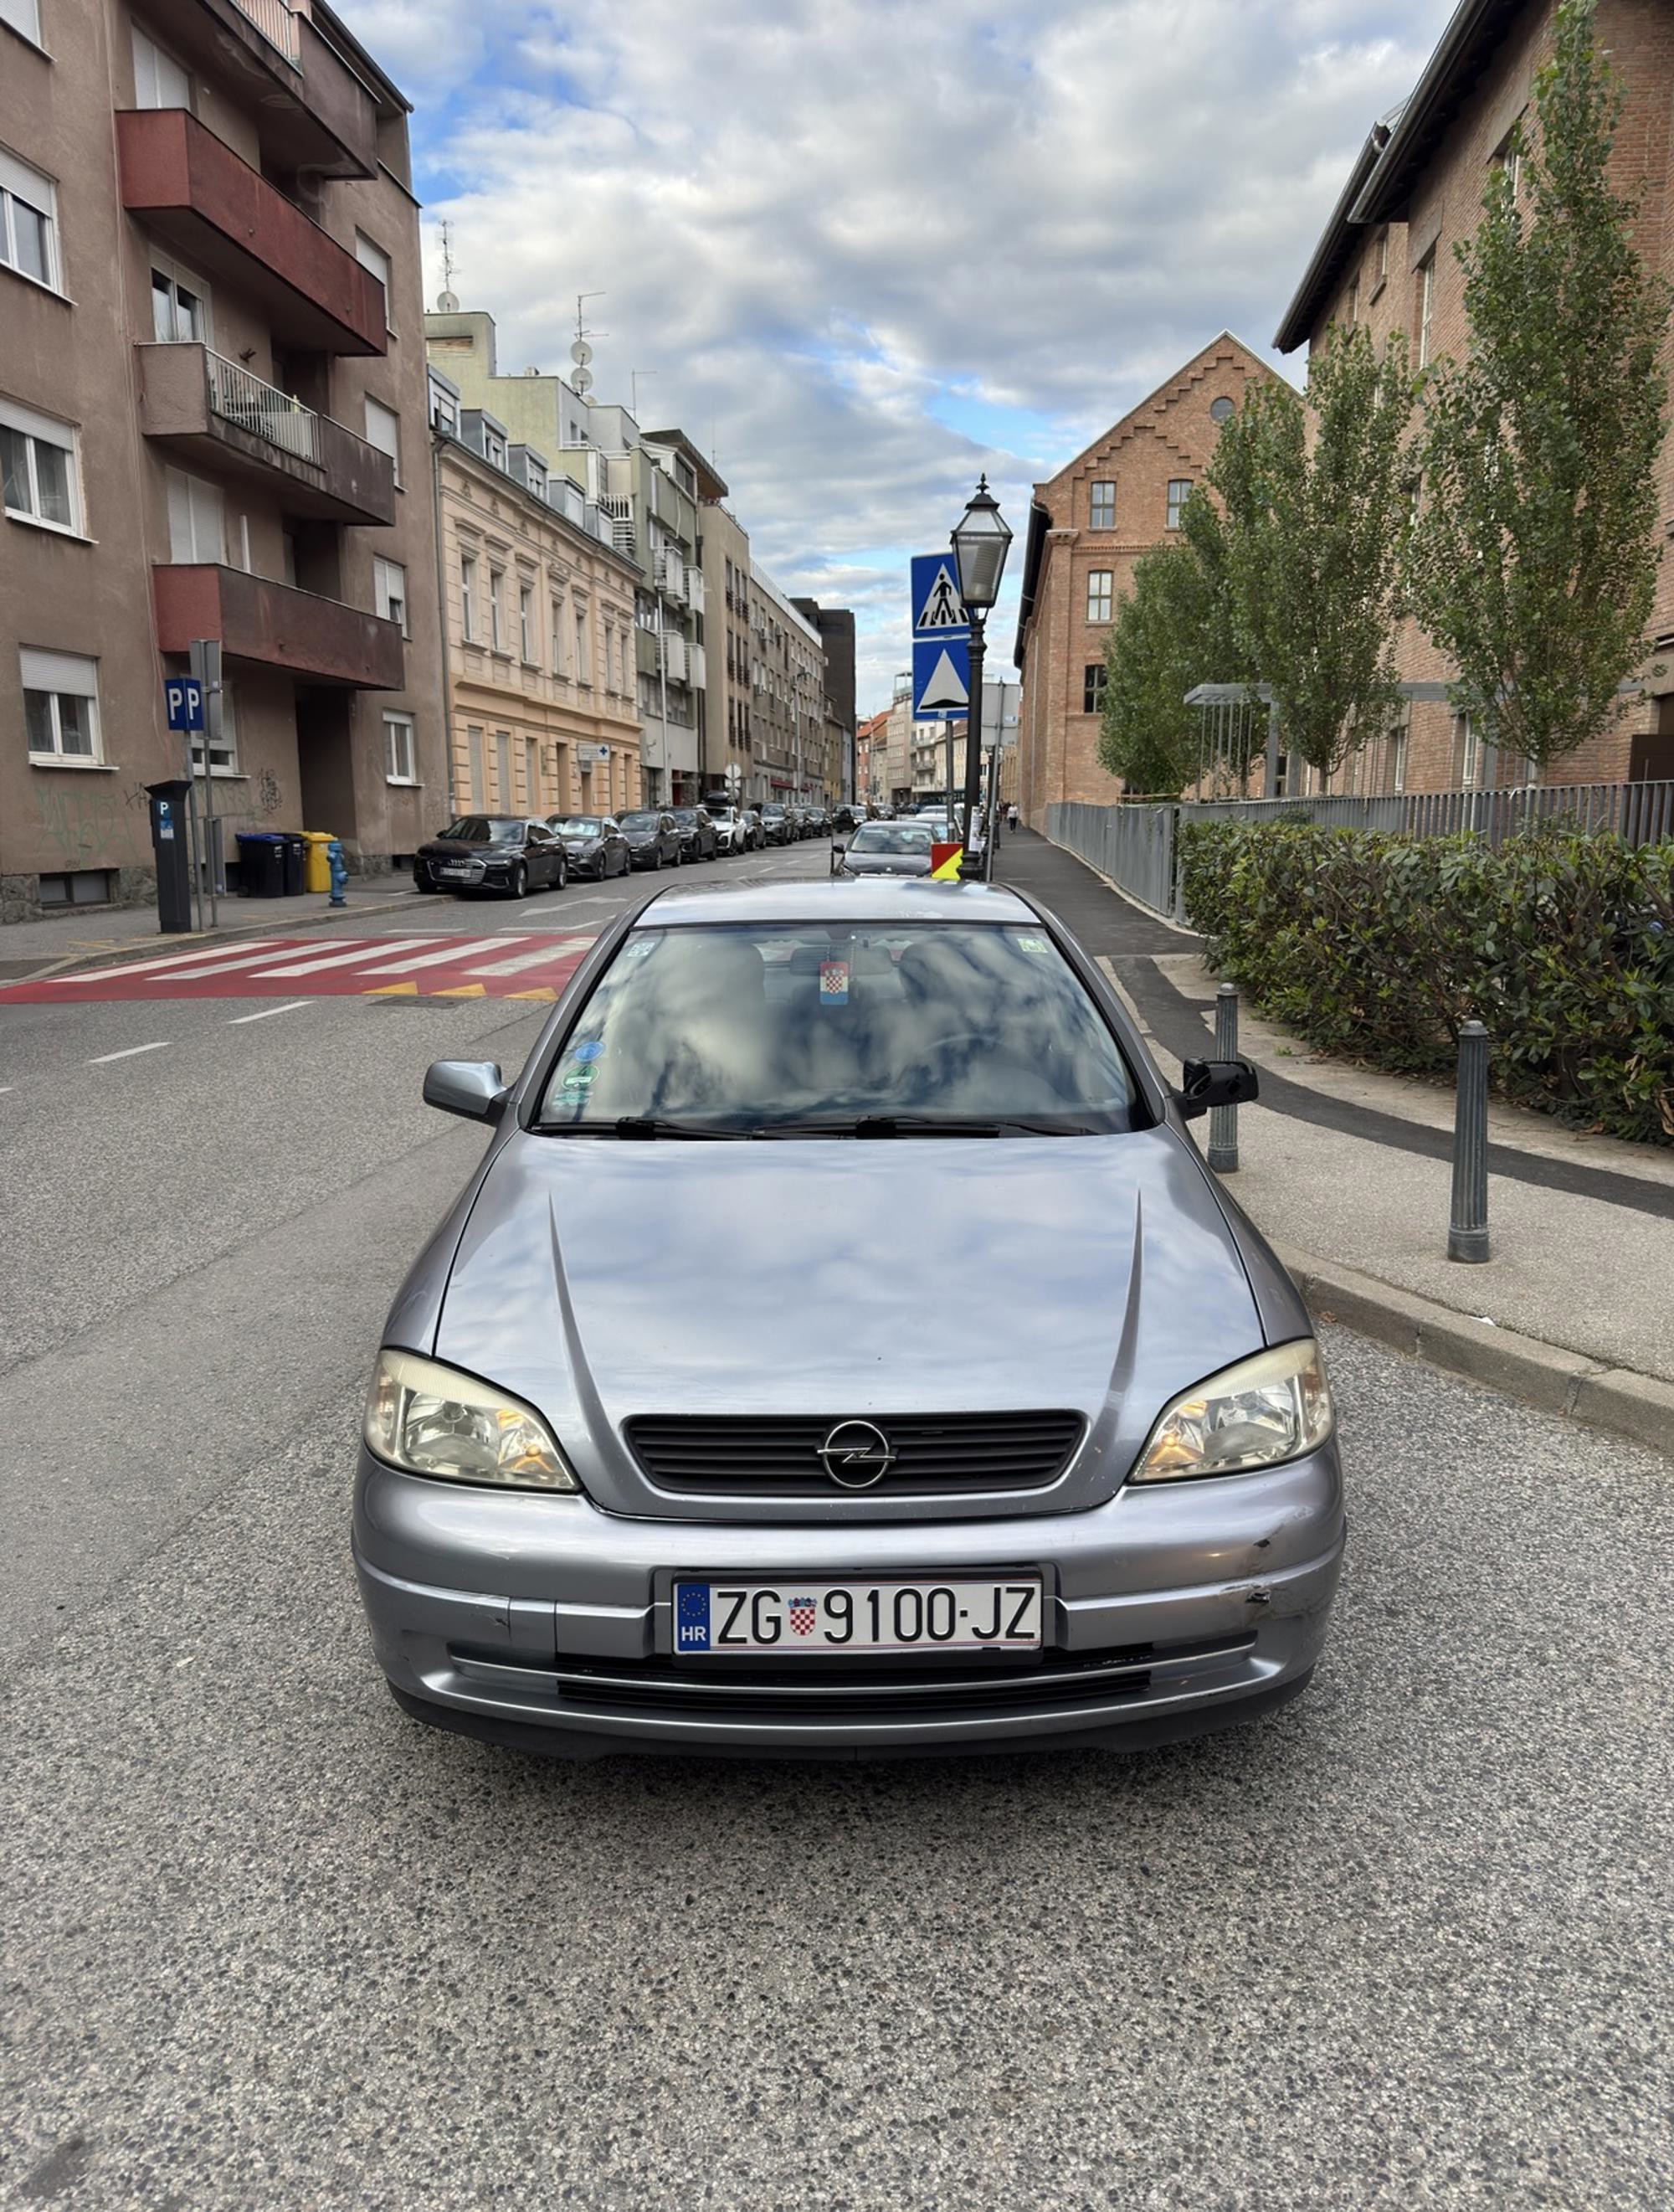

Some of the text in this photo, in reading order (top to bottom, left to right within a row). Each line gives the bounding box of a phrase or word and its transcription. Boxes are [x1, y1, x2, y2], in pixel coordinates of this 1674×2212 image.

[168, 687, 182, 721] P
[187, 687, 199, 720] P
[160, 801, 168, 815] P
[681, 1625, 706, 1642] HR
[716, 1589, 782, 1644] ZG
